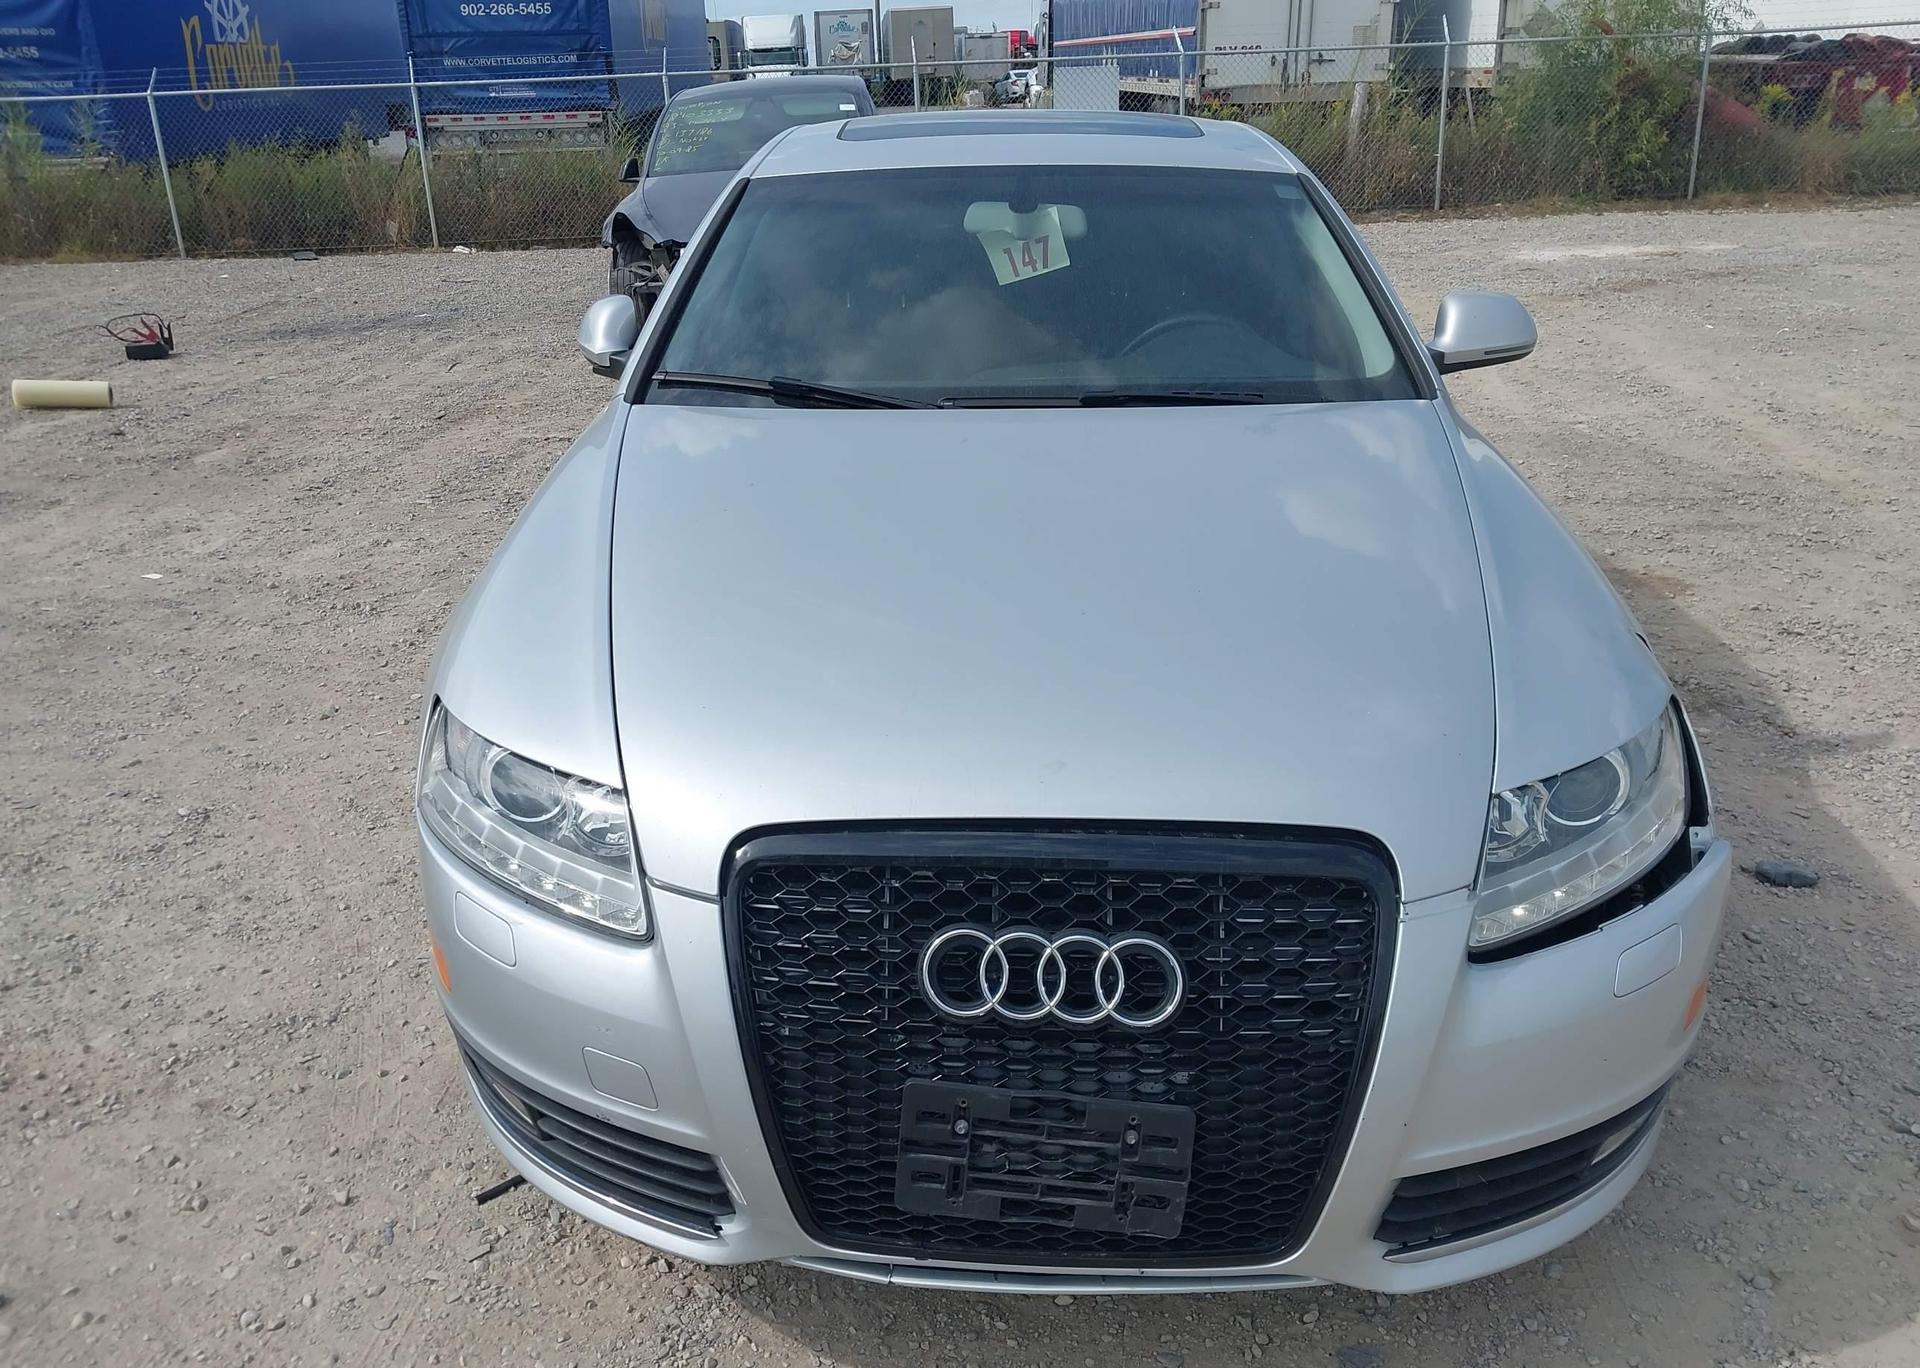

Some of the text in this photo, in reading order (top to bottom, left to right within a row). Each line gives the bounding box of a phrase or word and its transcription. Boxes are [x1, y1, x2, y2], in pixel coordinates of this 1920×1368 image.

[460, 3, 552, 16] 902-266-5455
[443, 54, 578, 66] WWW.CORVETTELOGISTICS.COM
[1002, 234, 1050, 278] 147
